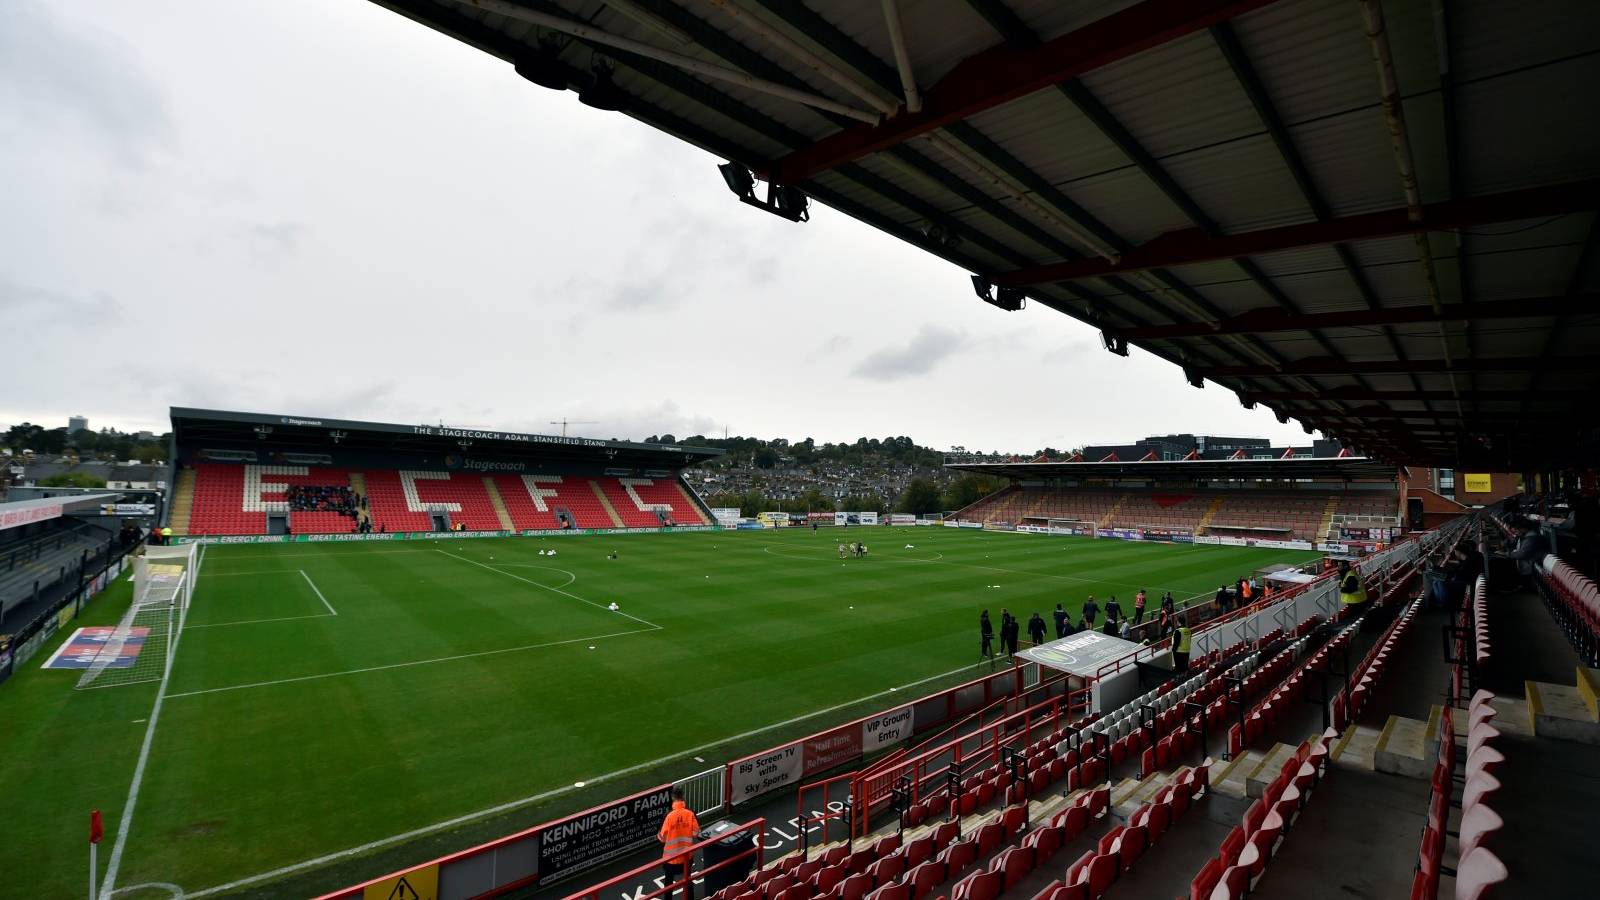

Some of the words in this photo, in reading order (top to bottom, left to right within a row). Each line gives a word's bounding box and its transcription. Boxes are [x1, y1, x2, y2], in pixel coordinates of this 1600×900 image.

[413, 426, 432, 436] THE
[439, 429, 500, 440] STAGECOACH
[504, 434, 529, 442] ADAM
[533, 436, 580, 445] STANSFIELD
[463, 458, 527, 472] Stagecoach
[220, 535, 256, 544] ENERGY
[257, 535, 285, 543] DRINK
[308, 534, 333, 542] GREAT
[335, 533, 364, 541] TASTING
[867, 720, 880, 733] VIP
[882, 709, 911, 727] Ground
[815, 739, 830, 752] Half
[833, 734, 851, 747] Time
[878, 727, 900, 743] Entry
[739, 762, 753, 775] Big
[756, 754, 783, 769] Screen
[785, 747, 795, 758] TV
[758, 764, 777, 776] with
[745, 781, 760, 794] Sky
[763, 772, 789, 787] Sports
[542, 805, 629, 846] KENNIFORD
[633, 790, 671, 814] FARM
[541, 841, 568, 857] SHOP
